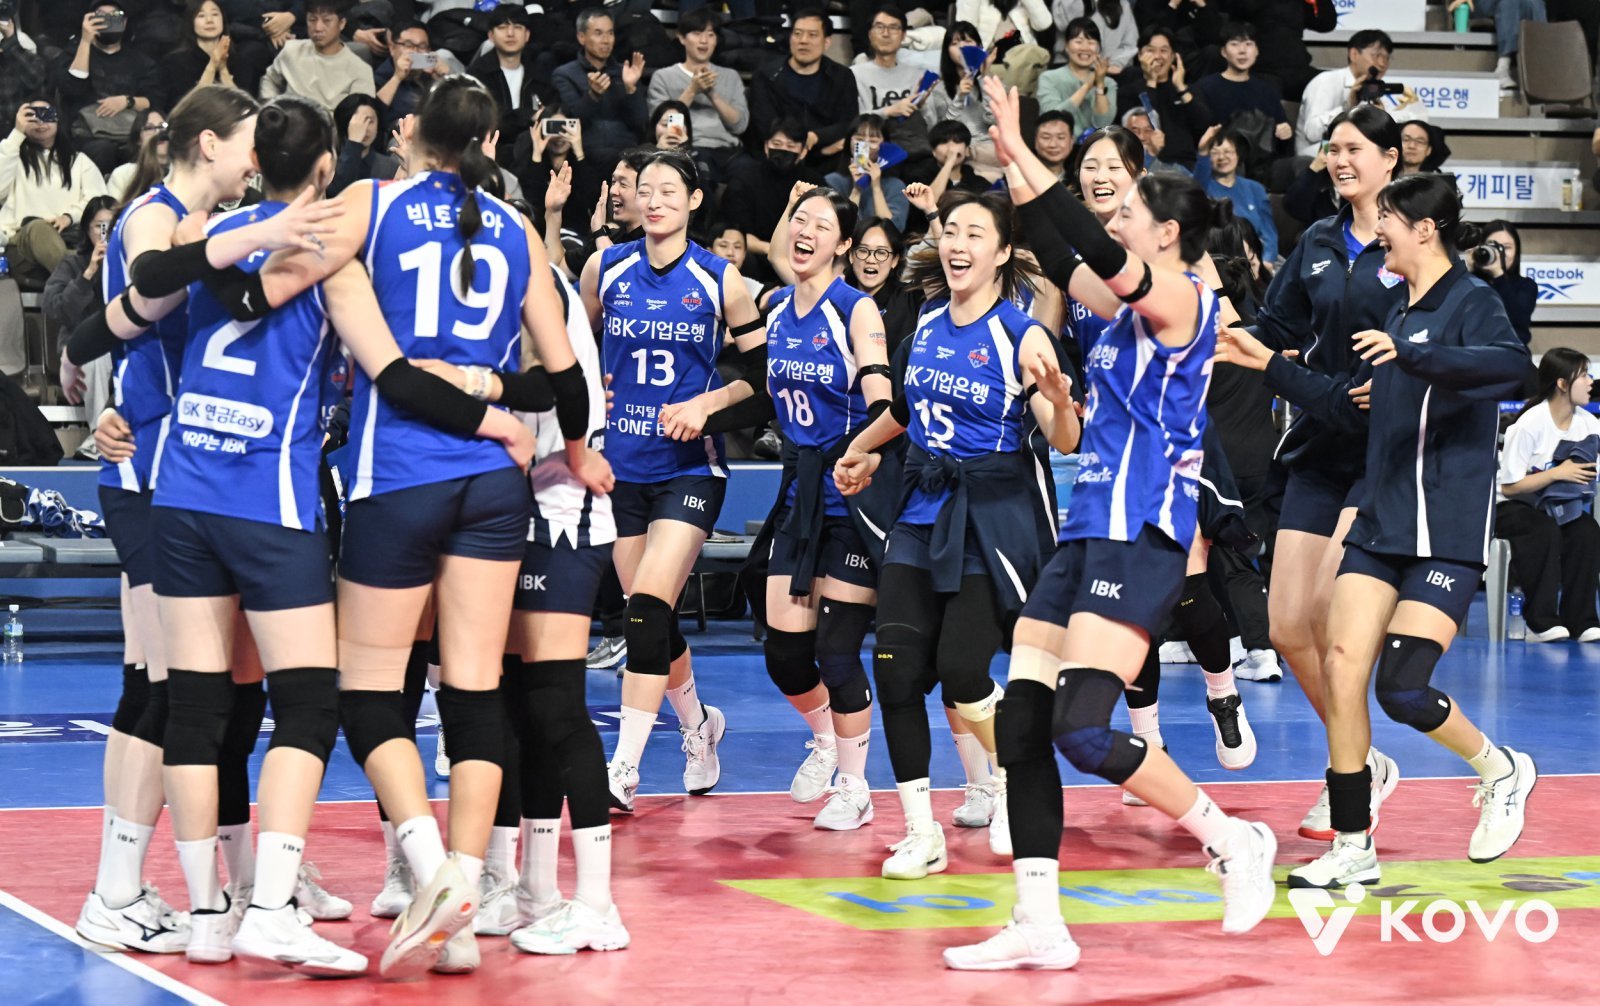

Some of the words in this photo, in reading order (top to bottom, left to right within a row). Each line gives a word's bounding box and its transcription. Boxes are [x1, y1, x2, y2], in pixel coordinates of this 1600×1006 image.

[1413, 87, 1469, 109] 업은행
[1467, 174, 1534, 200] 캐피탈
[405, 202, 505, 239] 빅토아
[1525, 267, 1584, 281] Reebok
[398, 241, 510, 341] 19
[638, 320, 706, 343] 기업은행
[202, 317, 263, 377] 2
[631, 348, 676, 387] 13
[777, 359, 834, 384] 기업은행
[922, 368, 990, 405] 기업은행
[625, 403, 656, 419] 디지털
[777, 388, 814, 427] 18
[914, 398, 955, 450] 15
[683, 494, 707, 512] IBK
[845, 553, 870, 570] IBK
[519, 574, 547, 591] IBK
[1090, 579, 1123, 600] IBK
[1425, 569, 1456, 592] IBK
[117, 833, 138, 845] IBK
